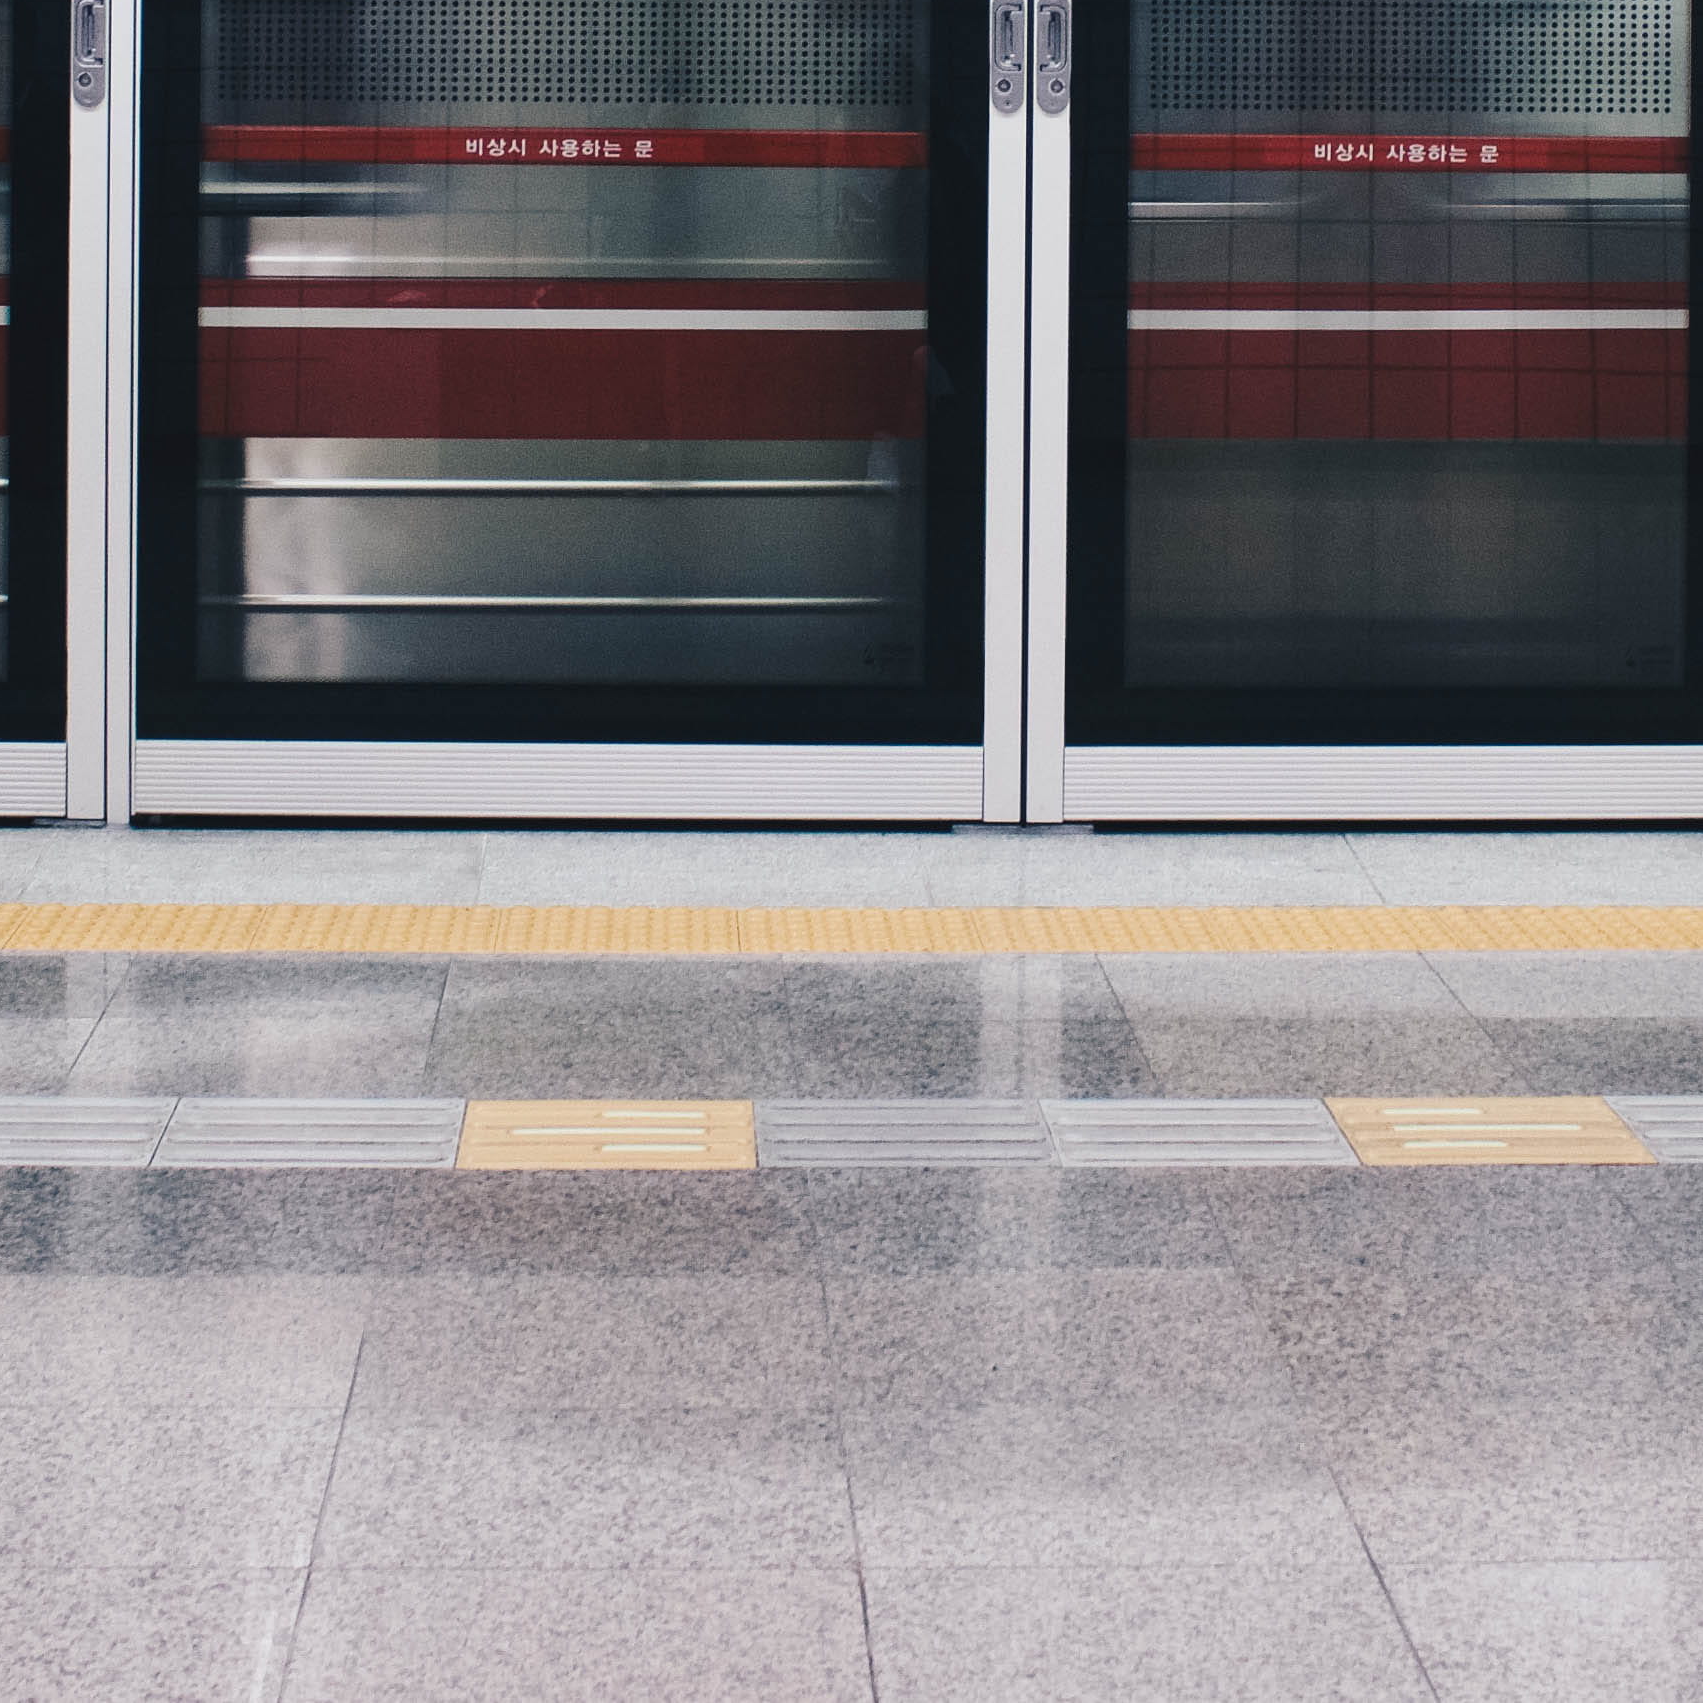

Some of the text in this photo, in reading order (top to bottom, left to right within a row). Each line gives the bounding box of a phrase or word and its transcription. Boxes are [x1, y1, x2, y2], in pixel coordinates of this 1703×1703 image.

[465, 138, 654, 159] 비상시 사용하는 문
[1314, 143, 1499, 164] 비상시 사용하는 문
